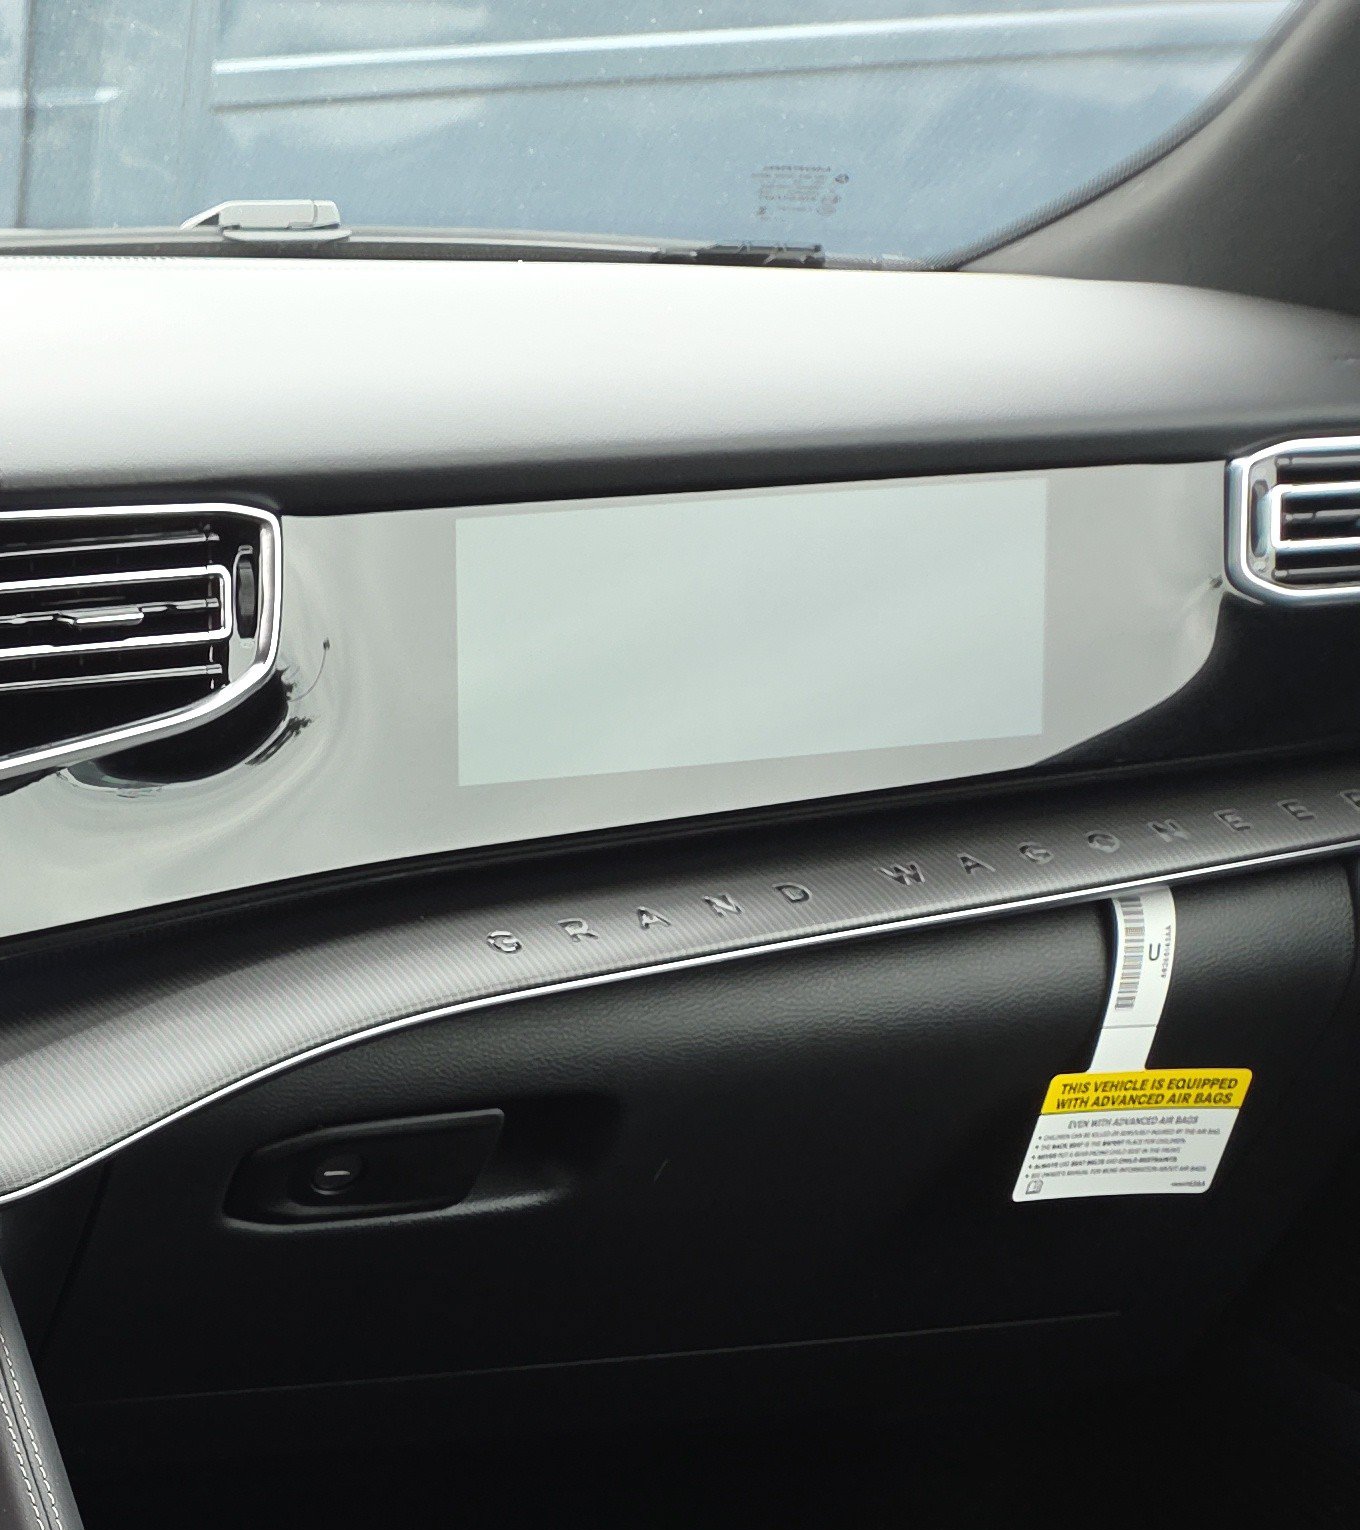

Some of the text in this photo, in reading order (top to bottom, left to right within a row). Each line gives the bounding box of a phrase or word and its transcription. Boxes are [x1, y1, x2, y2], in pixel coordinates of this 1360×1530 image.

[1061, 1076, 1239, 1095] THIS VEHICLE IS EQUIPPED
[1055, 1092, 1234, 1110] WITH ADVANCED AIR BAGS
